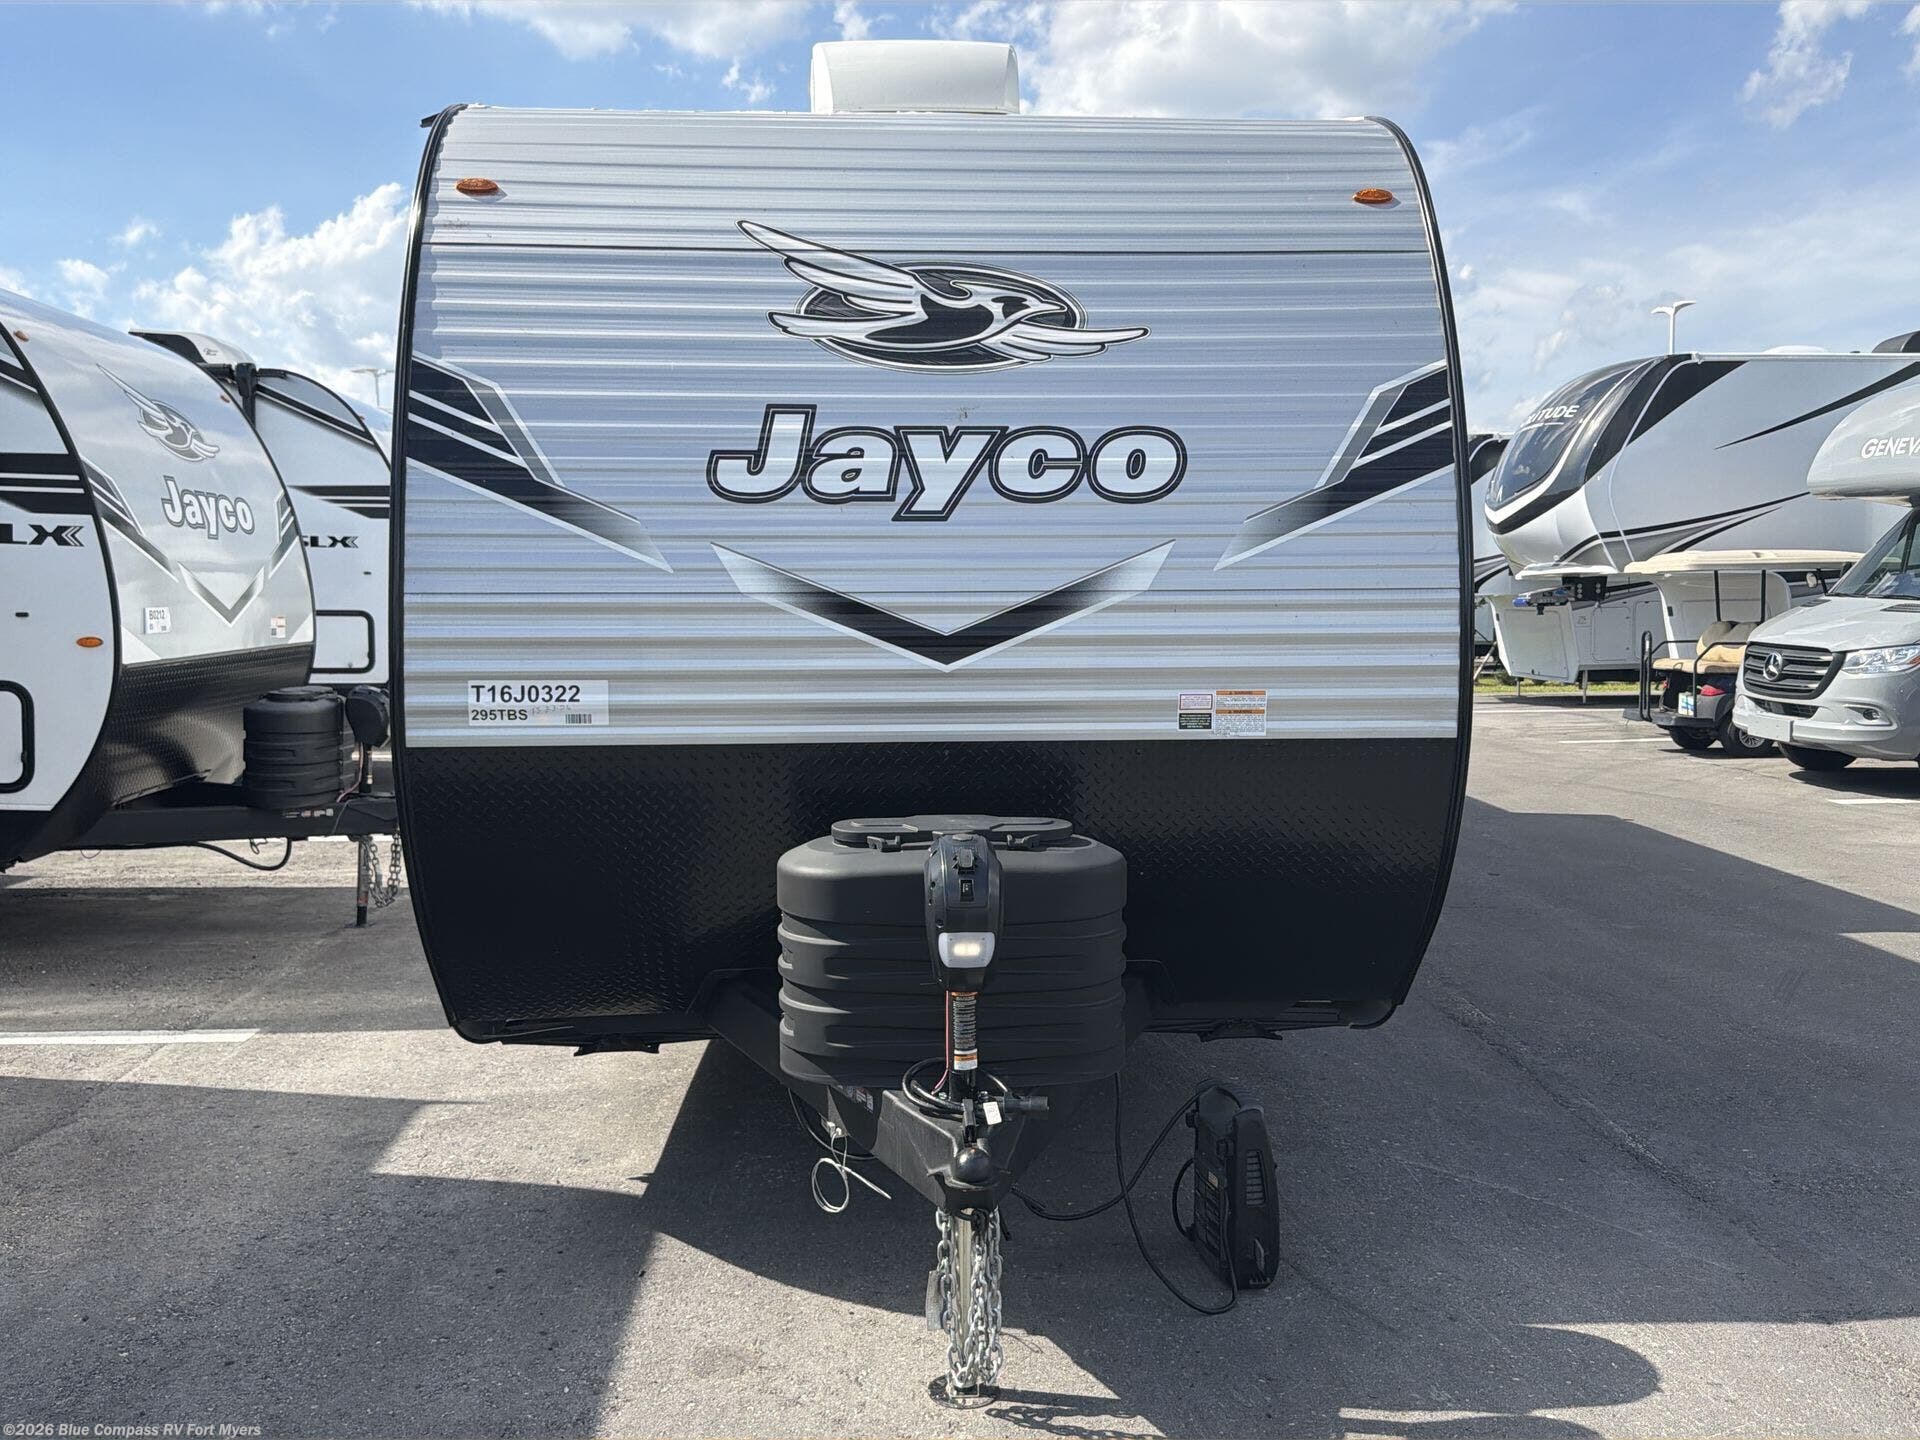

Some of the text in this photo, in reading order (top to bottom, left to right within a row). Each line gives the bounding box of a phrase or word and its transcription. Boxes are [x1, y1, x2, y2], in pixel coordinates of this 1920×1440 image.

[705, 403, 1188, 522] Jayco
[161, 475, 255, 540] Jayco
[471, 685, 581, 703] T16J0322
[471, 709, 529, 721] 295TBS
